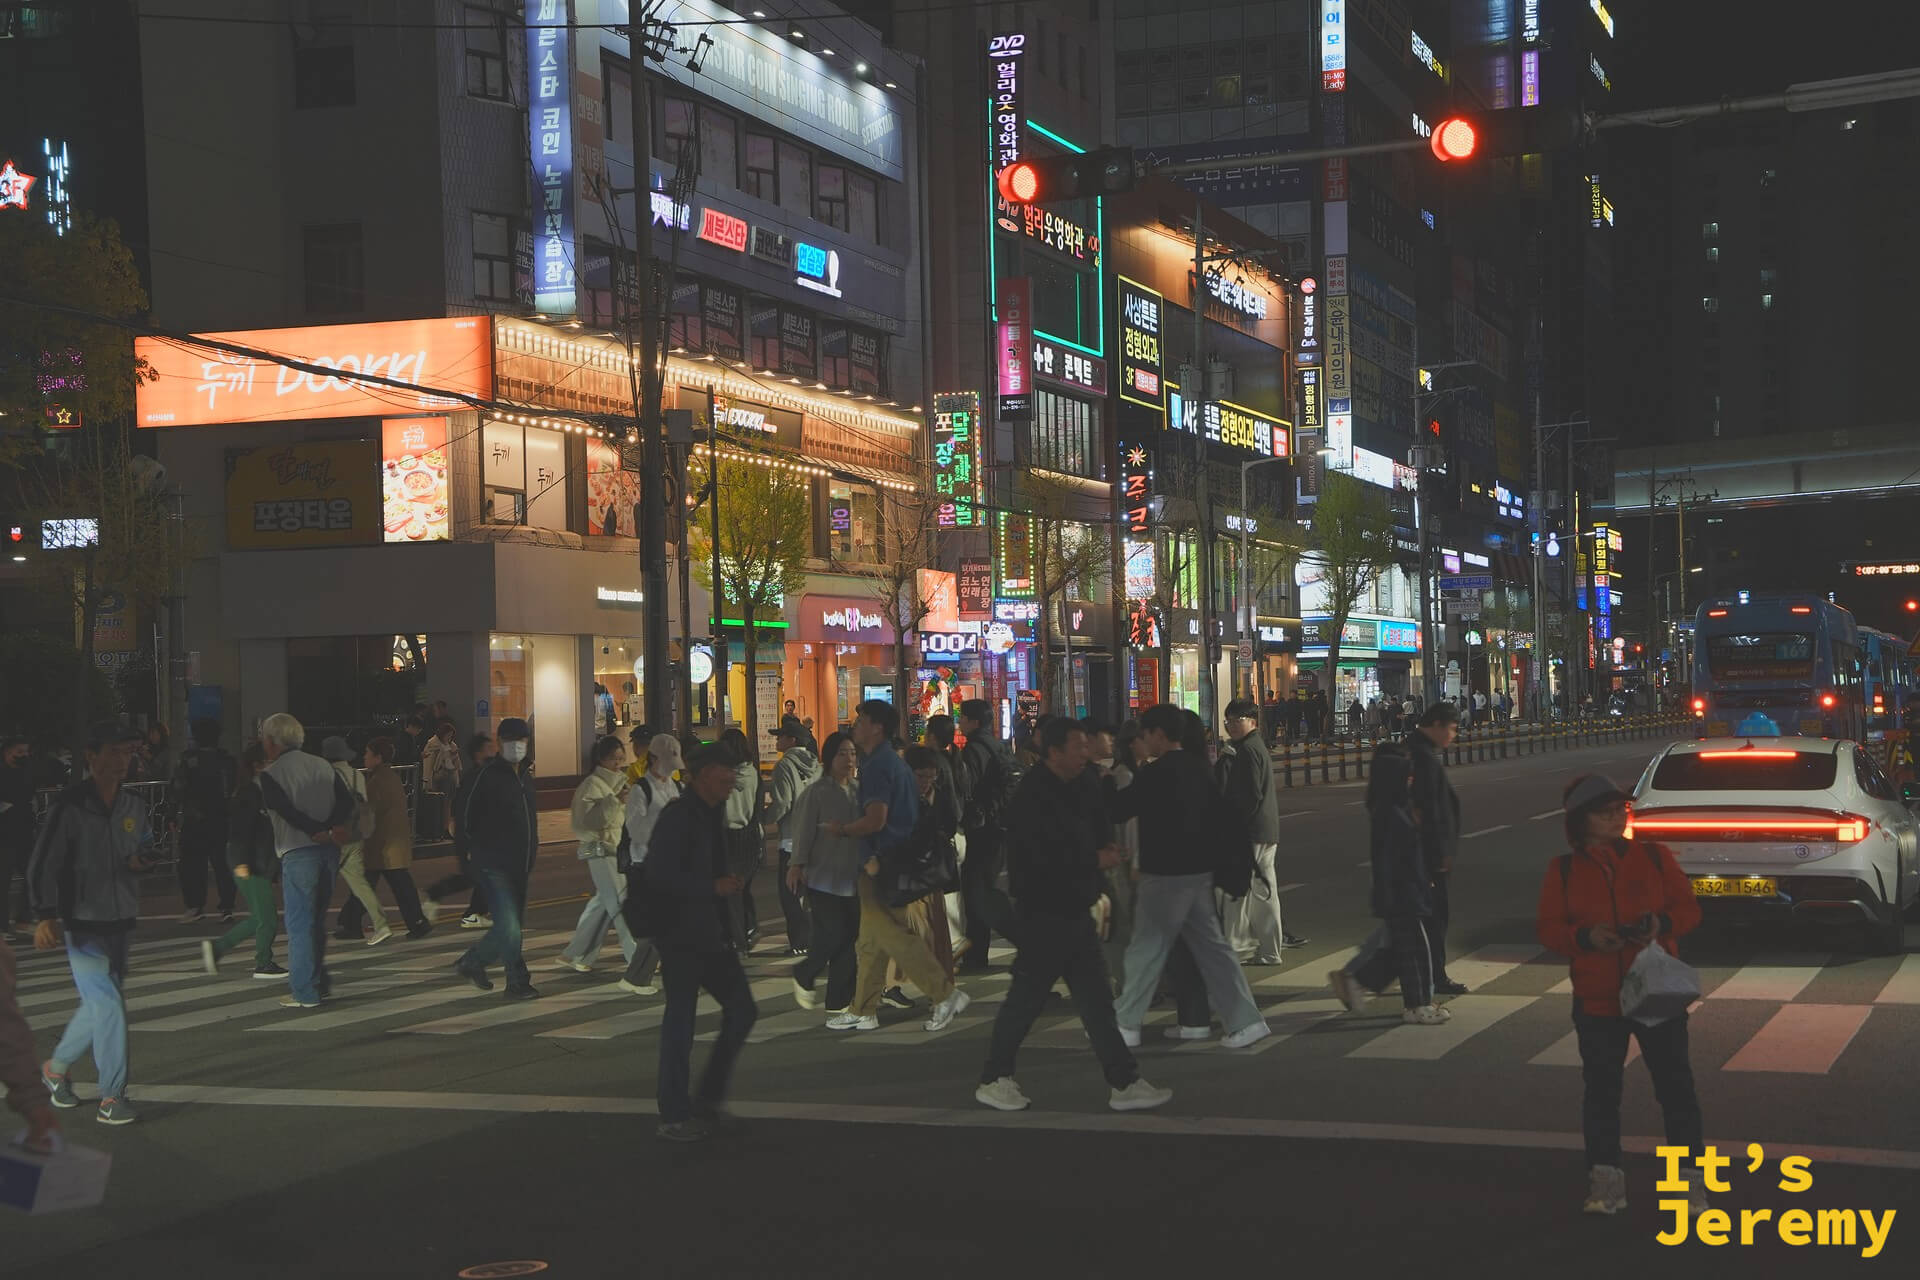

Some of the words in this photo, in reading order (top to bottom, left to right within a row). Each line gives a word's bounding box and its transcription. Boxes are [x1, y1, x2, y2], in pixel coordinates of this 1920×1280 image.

[1325, 0, 1341, 45] 이모
[990, 34, 1025, 50] DVD
[748, 55, 778, 96] COIN
[778, 70, 826, 120] SINGING
[828, 99, 859, 135] ROOM
[1324, 79, 1345, 89] Lady
[539, 107, 562, 154] 코인
[702, 210, 747, 251] 세븐스타
[798, 242, 827, 276] 연습장
[1328, 260, 1345, 269] 야간
[1124, 292, 1158, 333] 사상튼튼
[1124, 326, 1159, 363] 정형외과
[196, 357, 255, 411] 두끼
[274, 350, 426, 397] DOOKKI
[1125, 366, 1135, 386] 3F
[1333, 402, 1346, 412] 4F
[492, 442, 510, 467] 두끼
[538, 467, 554, 491] 두끼
[254, 499, 352, 531] 포장타운
[823, 609, 846, 629] baskin
[845, 607, 860, 632] BR
[1782, 644, 1810, 658] 169
[1735, 881, 1772, 894] 1546
